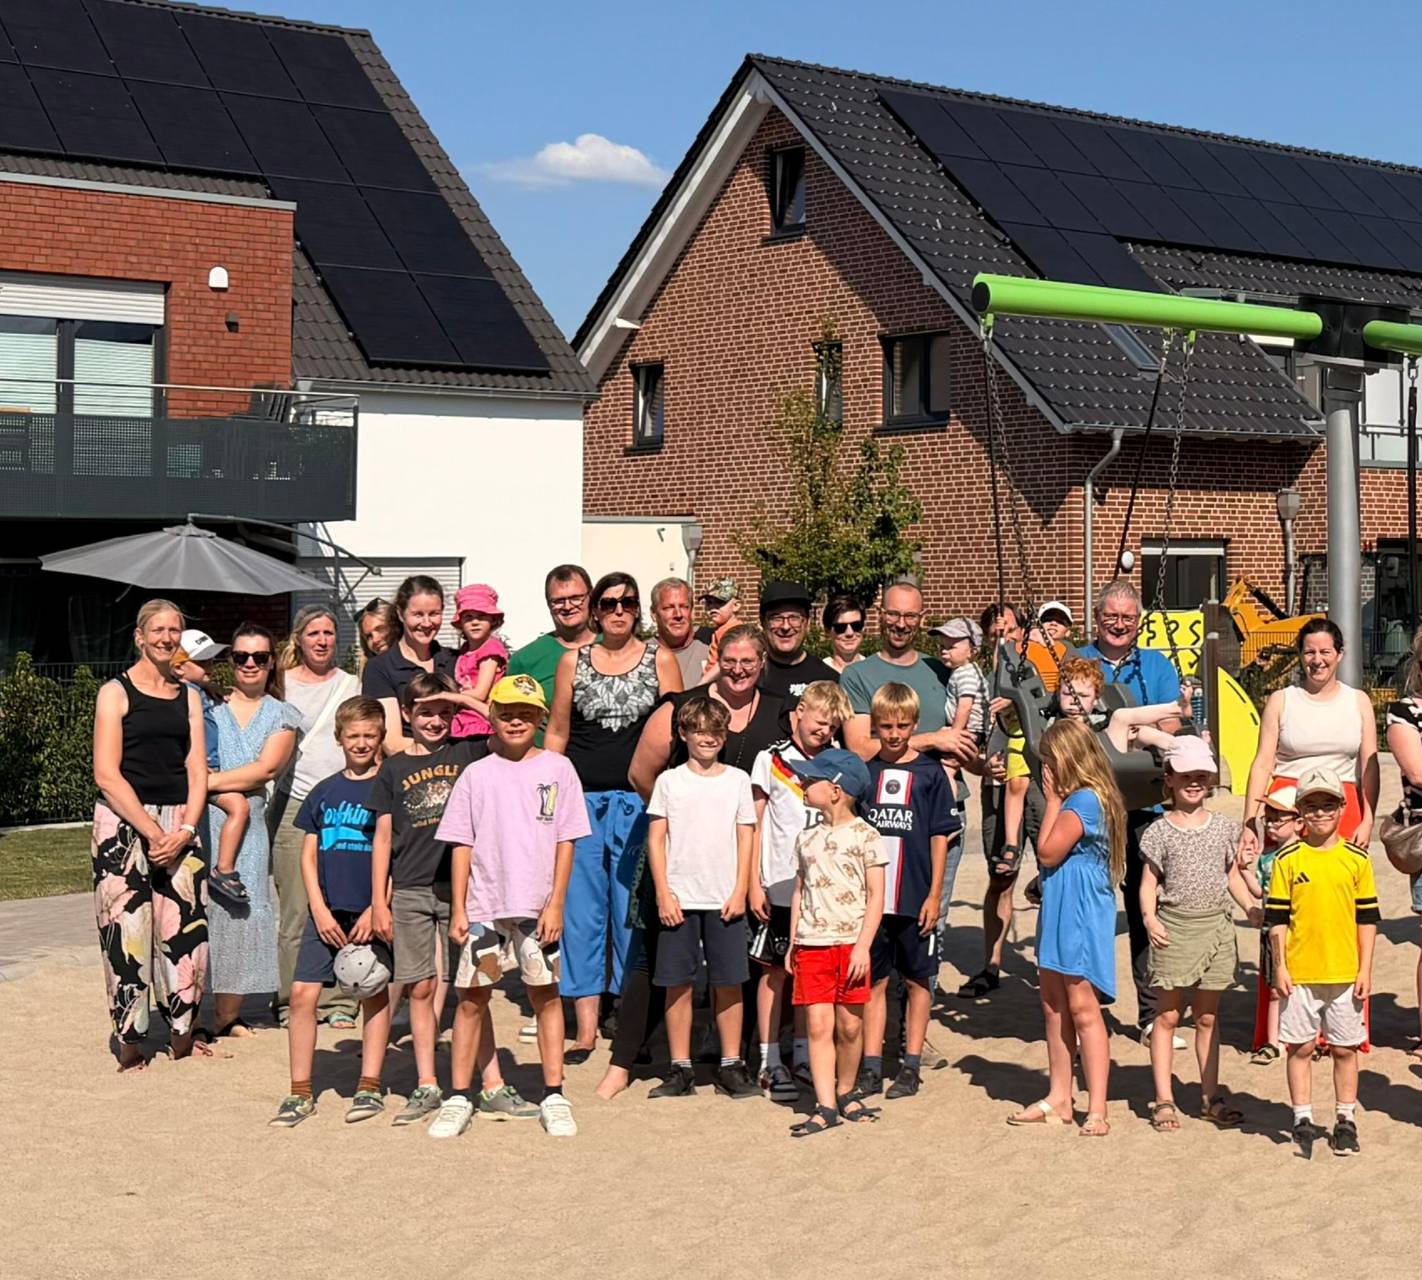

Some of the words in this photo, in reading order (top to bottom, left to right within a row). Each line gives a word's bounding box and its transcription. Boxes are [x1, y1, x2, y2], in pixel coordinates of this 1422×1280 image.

[320, 800, 372, 824] orfkin
[868, 808, 913, 822] QATAR
[876, 820, 912, 831] AIRWAYS
